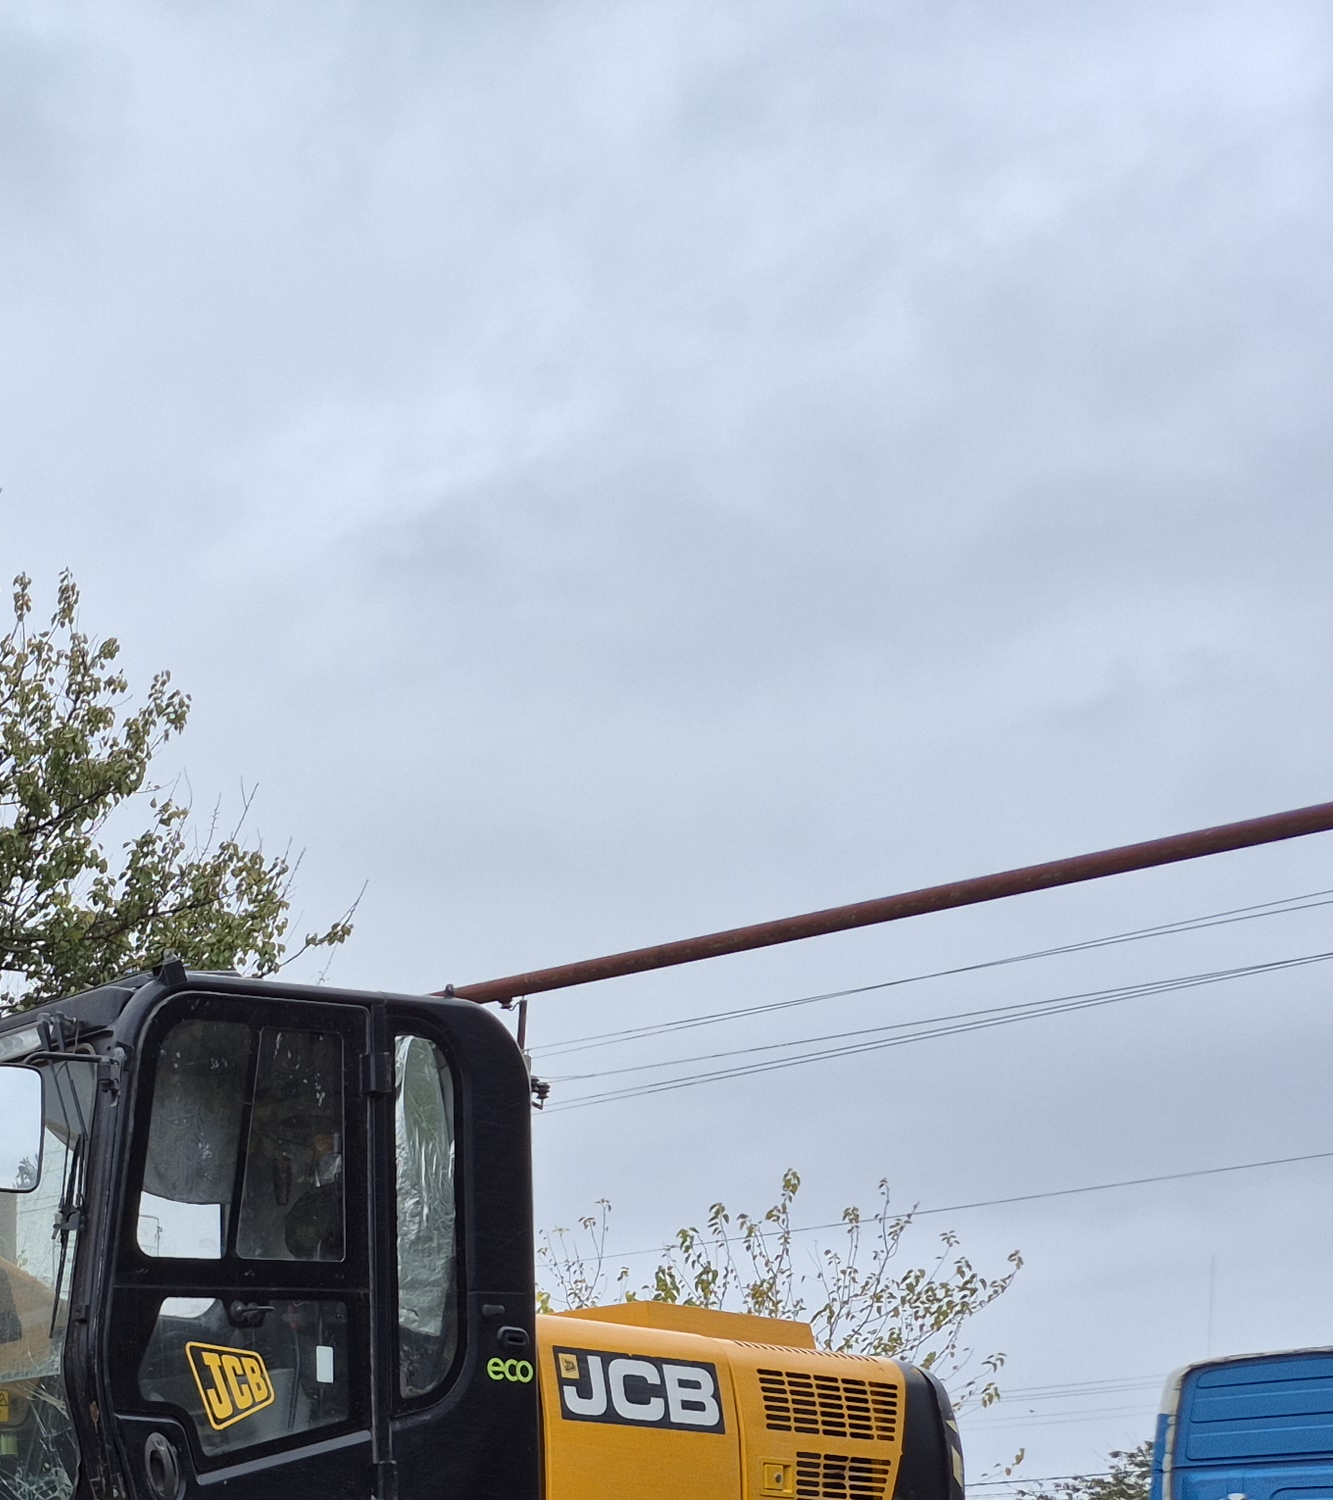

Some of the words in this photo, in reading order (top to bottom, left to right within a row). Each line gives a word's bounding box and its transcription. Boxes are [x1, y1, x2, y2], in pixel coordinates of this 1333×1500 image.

[201, 1351, 268, 1419] JCB
[487, 1357, 533, 1383] eco
[563, 1355, 720, 1427] JCB
